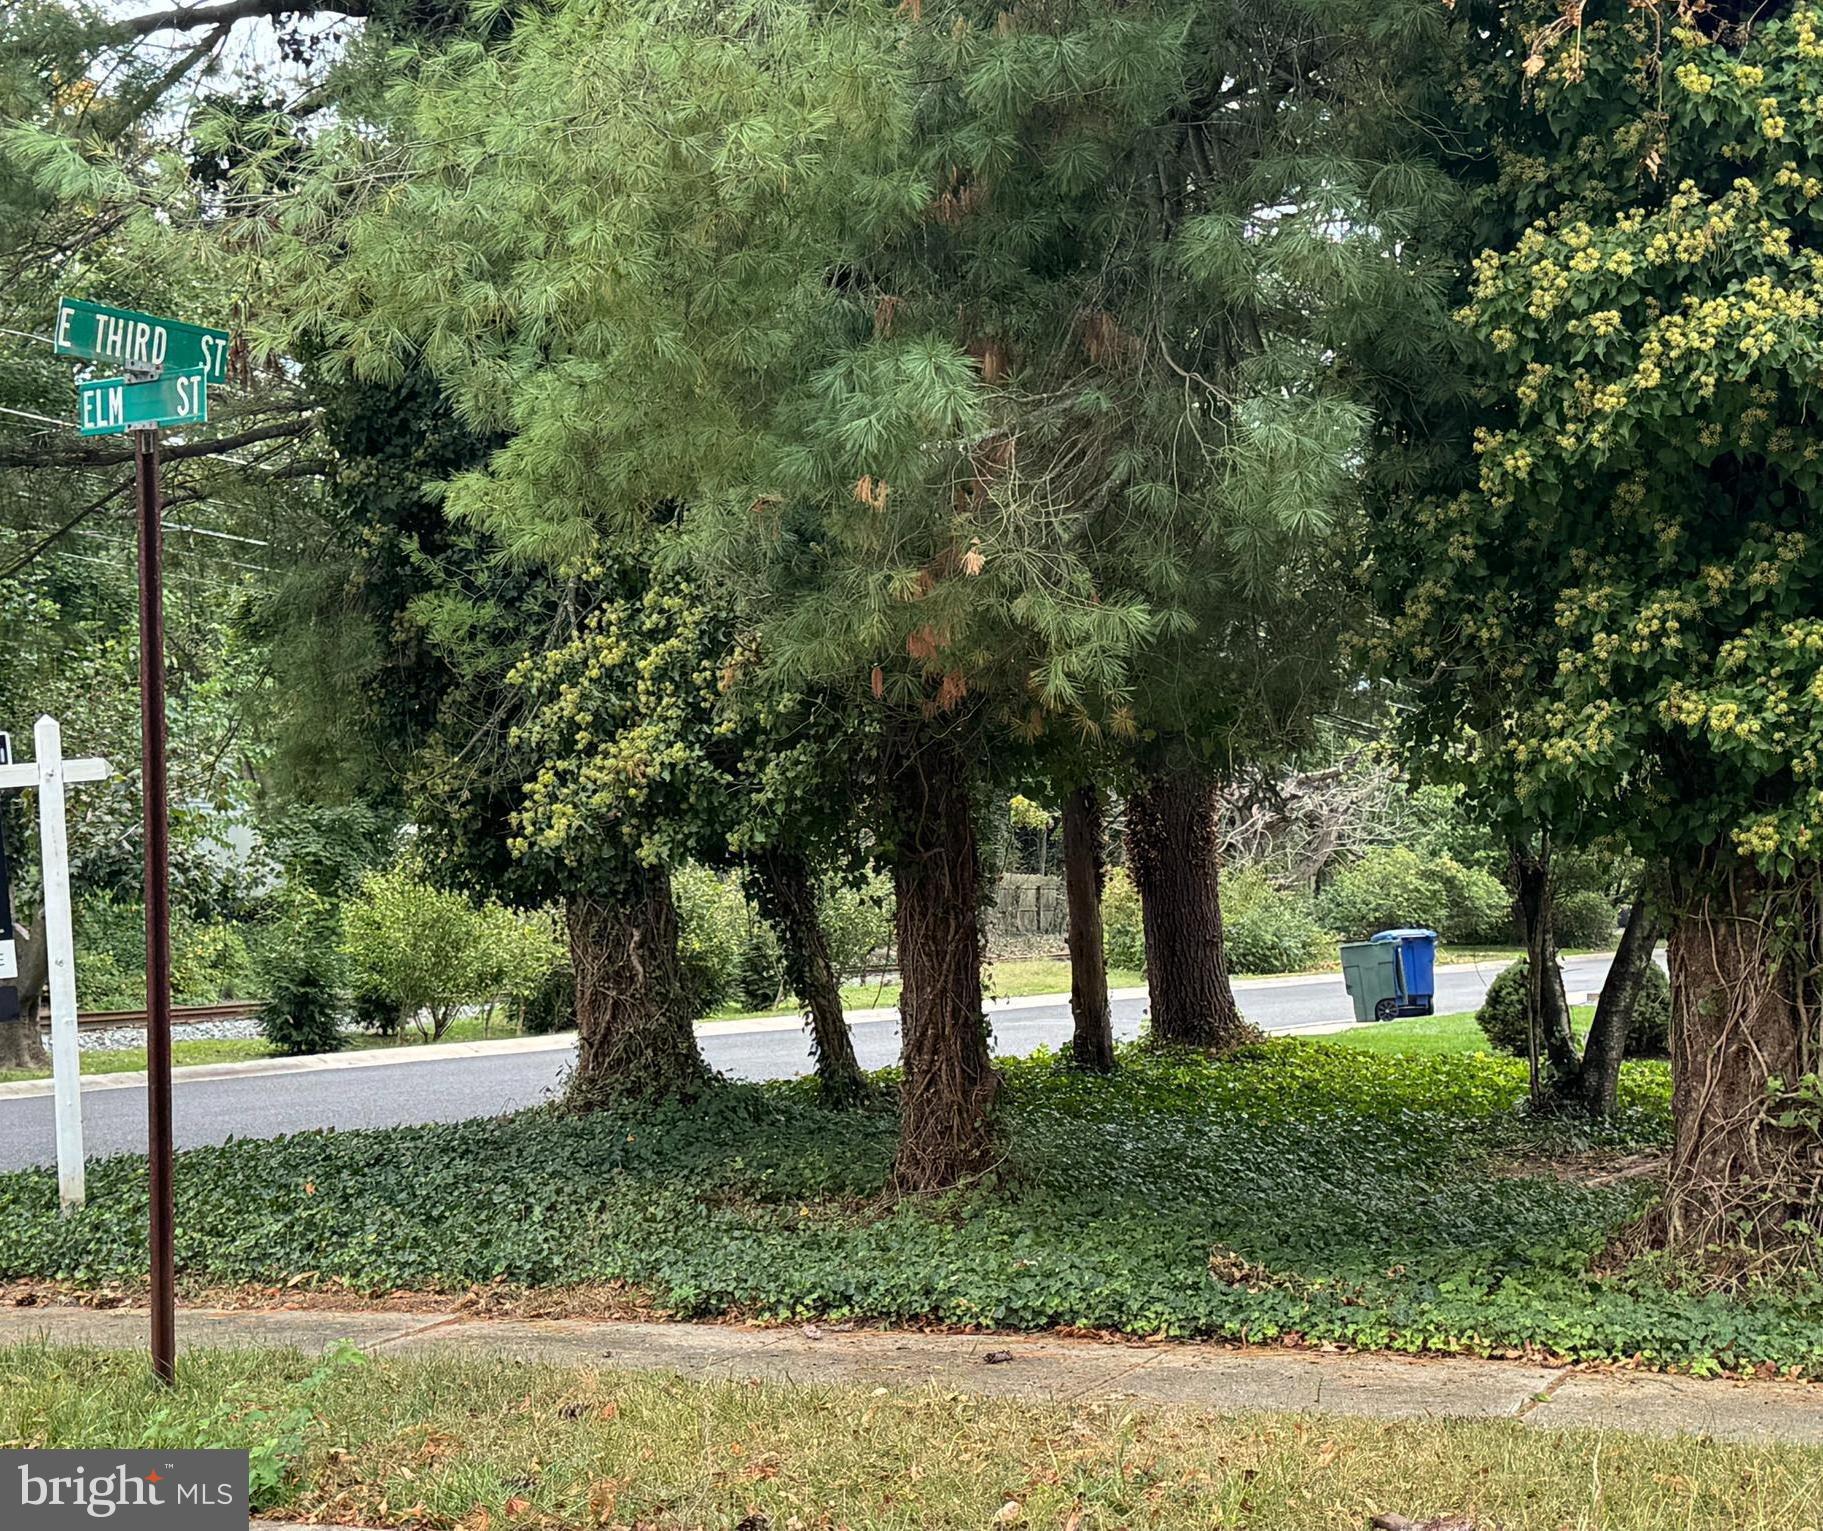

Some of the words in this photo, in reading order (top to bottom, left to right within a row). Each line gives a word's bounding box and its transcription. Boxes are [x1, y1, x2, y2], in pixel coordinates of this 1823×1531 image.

[58, 308, 75, 347] E
[95, 314, 168, 365] THIRD
[201, 334, 227, 377] ST
[83, 386, 123, 428] ELM
[176, 375, 202, 416] ST
